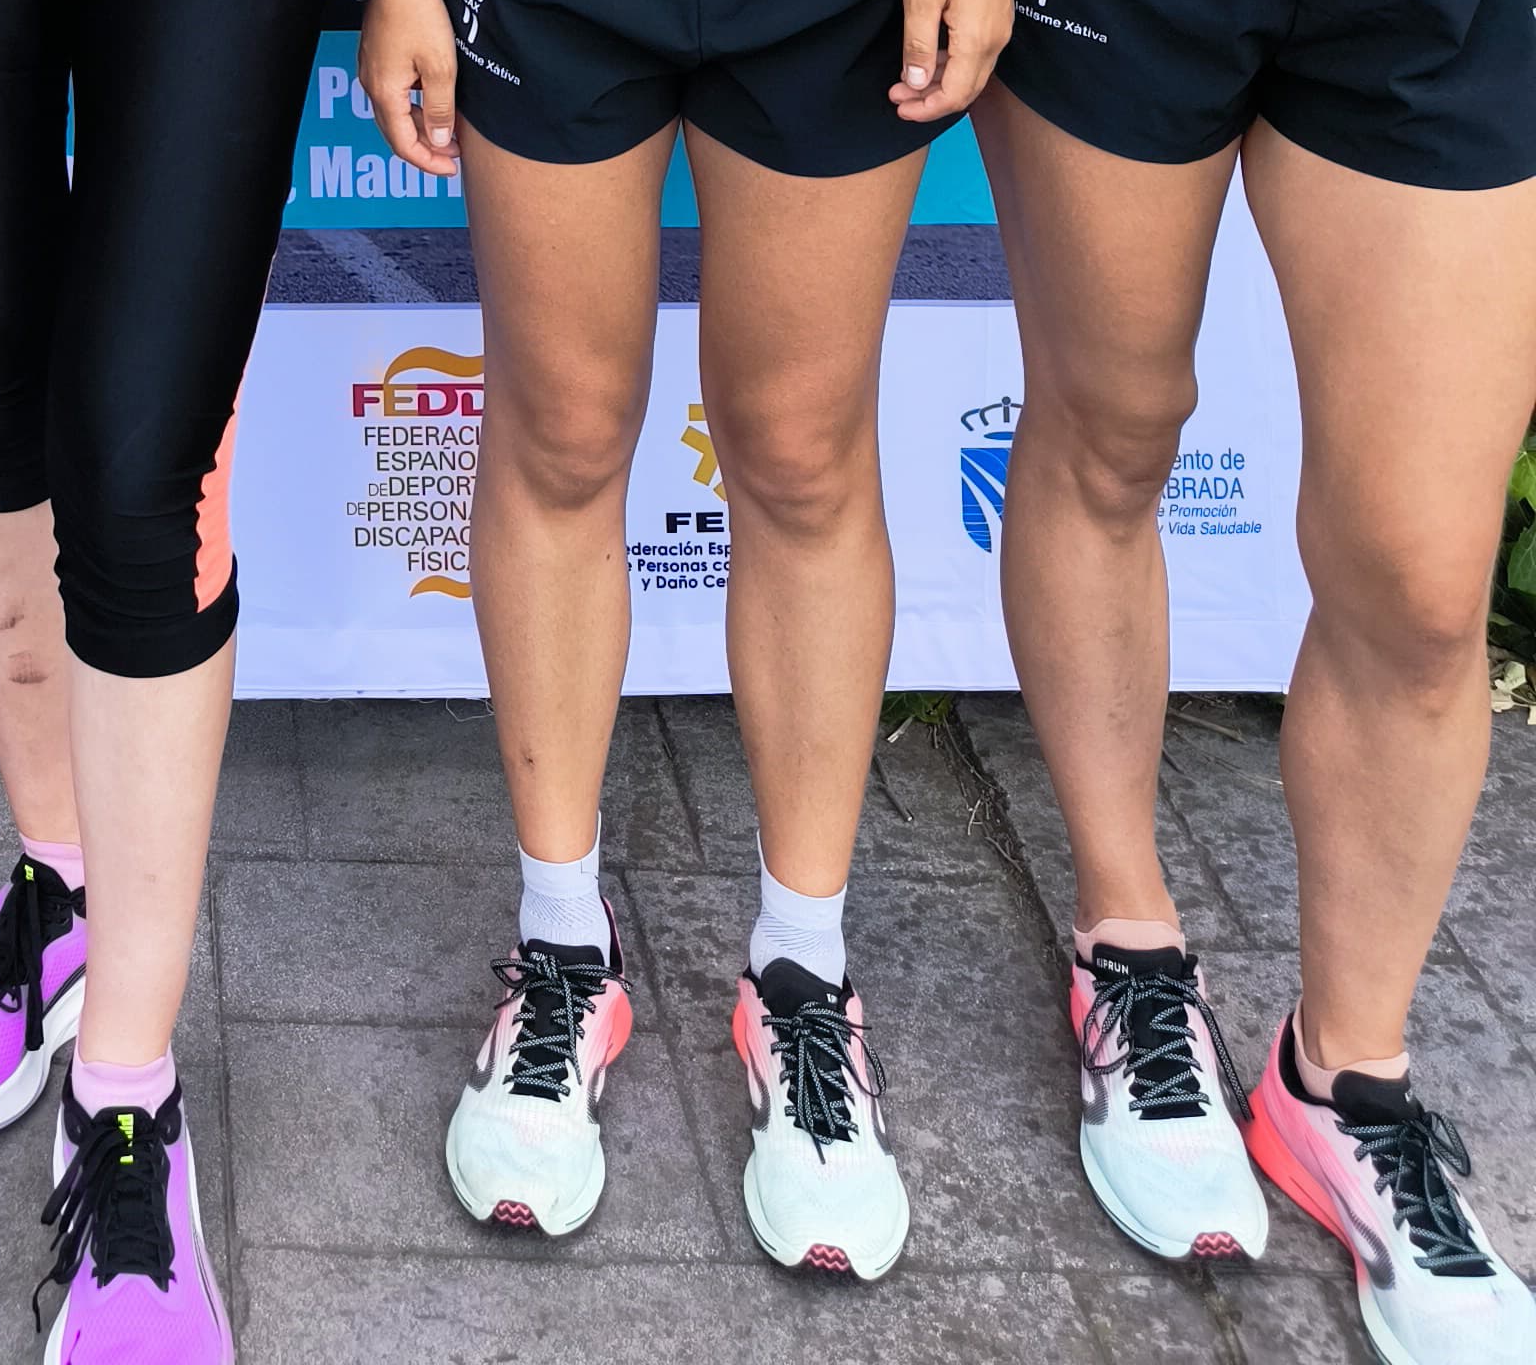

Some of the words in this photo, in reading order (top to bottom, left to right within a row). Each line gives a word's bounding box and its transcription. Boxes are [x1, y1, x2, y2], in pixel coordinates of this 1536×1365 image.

[1064, 20, 1108, 44] Xàtiva
[486, 59, 521, 86] Xàtiva
[364, 426, 480, 446] FEDERACI
[376, 446, 476, 471] ESPAÑO
[1220, 447, 1245, 471] de
[389, 476, 476, 496] DEPOR
[1162, 477, 1245, 499] BRADA
[367, 501, 471, 521] PERSON
[1169, 504, 1237, 517] Promoción
[1169, 521, 1196, 535] Vida
[1200, 520, 1262, 535] Saludable
[408, 546, 470, 571] FÍSIC
[637, 559, 708, 572] Personas
[641, 578, 651, 592] y
[656, 575, 698, 589] Daño
